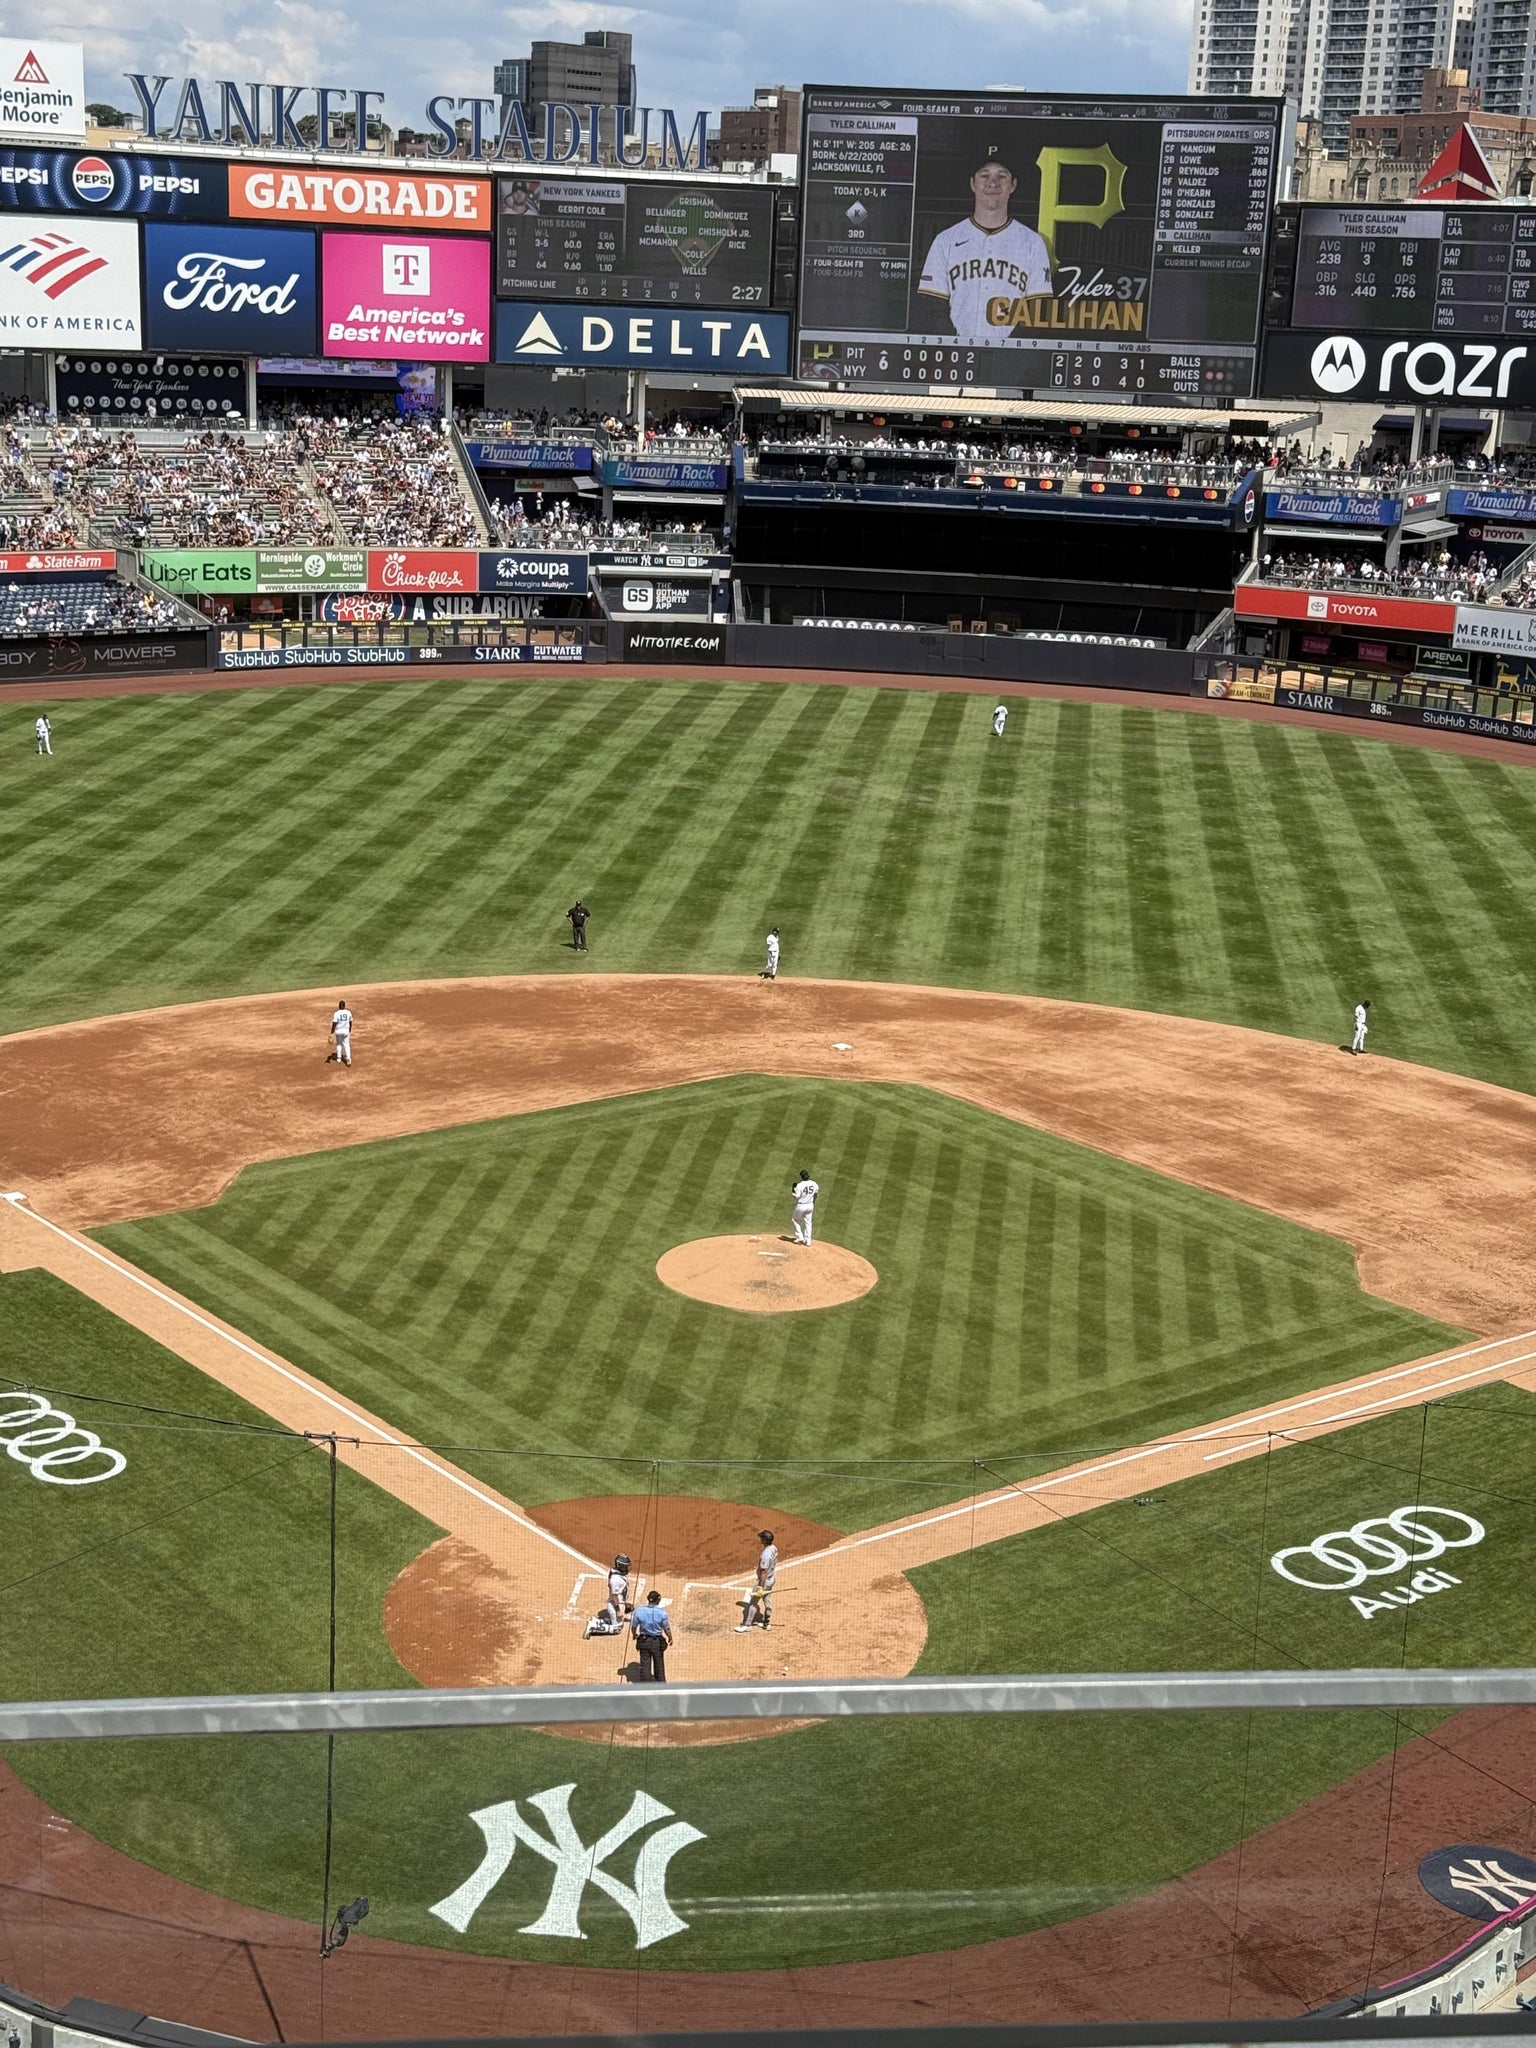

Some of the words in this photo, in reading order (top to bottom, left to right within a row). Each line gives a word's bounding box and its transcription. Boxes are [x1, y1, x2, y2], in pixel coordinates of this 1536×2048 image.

[0, 87, 73, 108] enjamin
[3, 105, 59, 124] Moore
[903, 104, 949, 113] FOUR-SEAM
[950, 105, 960, 114] FB
[123, 73, 386, 153] YANKEE
[426, 97, 712, 172] STADIUM
[830, 120, 855, 129] TYLER
[856, 120, 896, 130] CALLIHAN
[1167, 129, 1215, 139] PITTSBURGH
[1217, 130, 1250, 139] PIRATES
[1254, 131, 1270, 139] OPS
[813, 139, 822, 148] H:
[846, 141, 857, 149] W:
[858, 141, 875, 150] 205
[879, 142, 899, 151] AGE:
[900, 143, 911, 151] 26
[1180, 145, 1216, 154] MANGUM
[813, 151, 838, 160] BORN:
[839, 152, 884, 162] 6/22/2000
[1180, 156, 1202, 164] LOWE
[812, 162, 874, 174] JACKSONVILLE,
[875, 165, 885, 174] FL
[1179, 167, 1219, 176] REYNOLDS
[0, 167, 48, 185] EPSI
[76, 173, 112, 185] PEPSI
[139, 175, 200, 194] PEPSI
[1178, 178, 1207, 187] VALDEZ
[245, 174, 478, 218] GATORADE
[543, 187, 562, 195] NEW
[564, 188, 584, 197] YORK
[586, 189, 621, 198] YANKEES
[834, 187, 863, 196] TODAY:
[880, 188, 887, 197] K
[1177, 189, 1211, 198] O'HEARN
[679, 197, 714, 207] GRISHAM
[1036, 142, 1129, 267] P
[1176, 200, 1215, 209] GONZALES
[558, 206, 585, 215] GERRIT
[587, 207, 606, 215] COLE
[646, 208, 686, 218] BELLINGER
[1175, 211, 1214, 220] GONZALEZ
[1339, 214, 1364, 223] TYLER
[1366, 214, 1407, 224] CALLIHAN
[644, 225, 688, 235] CABALLERO
[1174, 221, 1198, 230] DAVIS
[1345, 225, 1363, 234] THIS
[1365, 225, 1399, 235] SEASON
[698, 227, 737, 238] CHISHOLM
[739, 229, 751, 238] JR.
[848, 230, 865, 238] 3RD
[1174, 232, 1211, 241] CALLIHAN
[639, 237, 678, 247] MCMAHON
[728, 241, 746, 250] RICE
[1319, 240, 1341, 251] AVG
[1360, 242, 1376, 253] HR
[1400, 242, 1418, 253] RBI
[685, 250, 704, 259] COLE
[1173, 245, 1201, 254] KELLER
[1316, 253, 1342, 265] .238
[1402, 255, 1414, 266] 15
[682, 267, 707, 276] WELLS
[949, 258, 1028, 293] PIRATES
[163, 252, 300, 315] Ford
[503, 279, 538, 288] PITCHING
[540, 279, 557, 288] LINE
[1316, 271, 1338, 283] OBP
[1354, 272, 1375, 284] SLG
[1394, 273, 1416, 285] OPS
[732, 286, 762, 300] 2:27
[1058, 266, 1115, 308] Tyler
[1116, 276, 1148, 301] 37
[1315, 284, 1337, 296] .316
[1350, 286, 1377, 297] .440
[1391, 286, 1416, 298] .756
[347, 304, 465, 326] America's
[988, 296, 1144, 332] CALLIHAN
[0, 315, 20, 328] NK
[26, 316, 48, 328] OF
[54, 317, 135, 331] AMERICA
[328, 323, 381, 343] Best
[385, 327, 485, 347] Network
[582, 315, 771, 359] DELTA
[847, 347, 865, 359] PIT
[1170, 356, 1201, 367] BALLS
[843, 365, 866, 377] NYY
[1159, 368, 1200, 380] STRIKES
[1379, 341, 1527, 399] razr
[112, 378, 131, 389] New
[133, 380, 153, 394] York
[155, 380, 189, 395] Yankees
[1173, 381, 1199, 392] OUTS
[480, 445, 540, 463] Plymouth
[543, 447, 575, 461] Rock
[531, 460, 575, 469] assurance
[615, 462, 678, 481] Plymouth
[681, 465, 716, 480] Rock
[669, 479, 713, 488] assurance
[1277, 495, 1342, 512] Plymouth
[1345, 499, 1381, 515] Rock
[1464, 492, 1527, 511] Plymouth
[1485, 530, 1525, 540] TOYOTA
[260, 553, 302, 564] Morningside
[326, 552, 363, 562] Workmen's
[614, 556, 638, 564] WATCH
[150, 563, 197, 582] Uber
[202, 563, 251, 581] Eats
[342, 562, 363, 571] Circle
[520, 562, 569, 579] coupa
[628, 588, 648, 602] GS
[656, 589, 689, 597] GOTHAM
[656, 596, 686, 604] SPORTS
[412, 597, 426, 620] A
[1331, 603, 1378, 617] TOYOTA
[1457, 624, 1524, 641] MERRILL
[630, 634, 720, 651] NITTOTIRE.COM
[94, 646, 177, 661] MOWERS
[475, 647, 520, 660] STARR
[534, 646, 582, 655] CUTWATER
[224, 651, 279, 668] StubHub
[285, 650, 341, 666] StubHub
[347, 649, 405, 663] StubHub
[1423, 651, 1463, 663] ARENA
[1288, 690, 1333, 711] STARR
[1423, 712, 1465, 728] StubHub
[1469, 718, 1509, 735] StubHub
[339, 1013, 348, 1022] 19
[803, 1185, 814, 1195] 45
[1349, 1567, 1463, 1620] Audi
